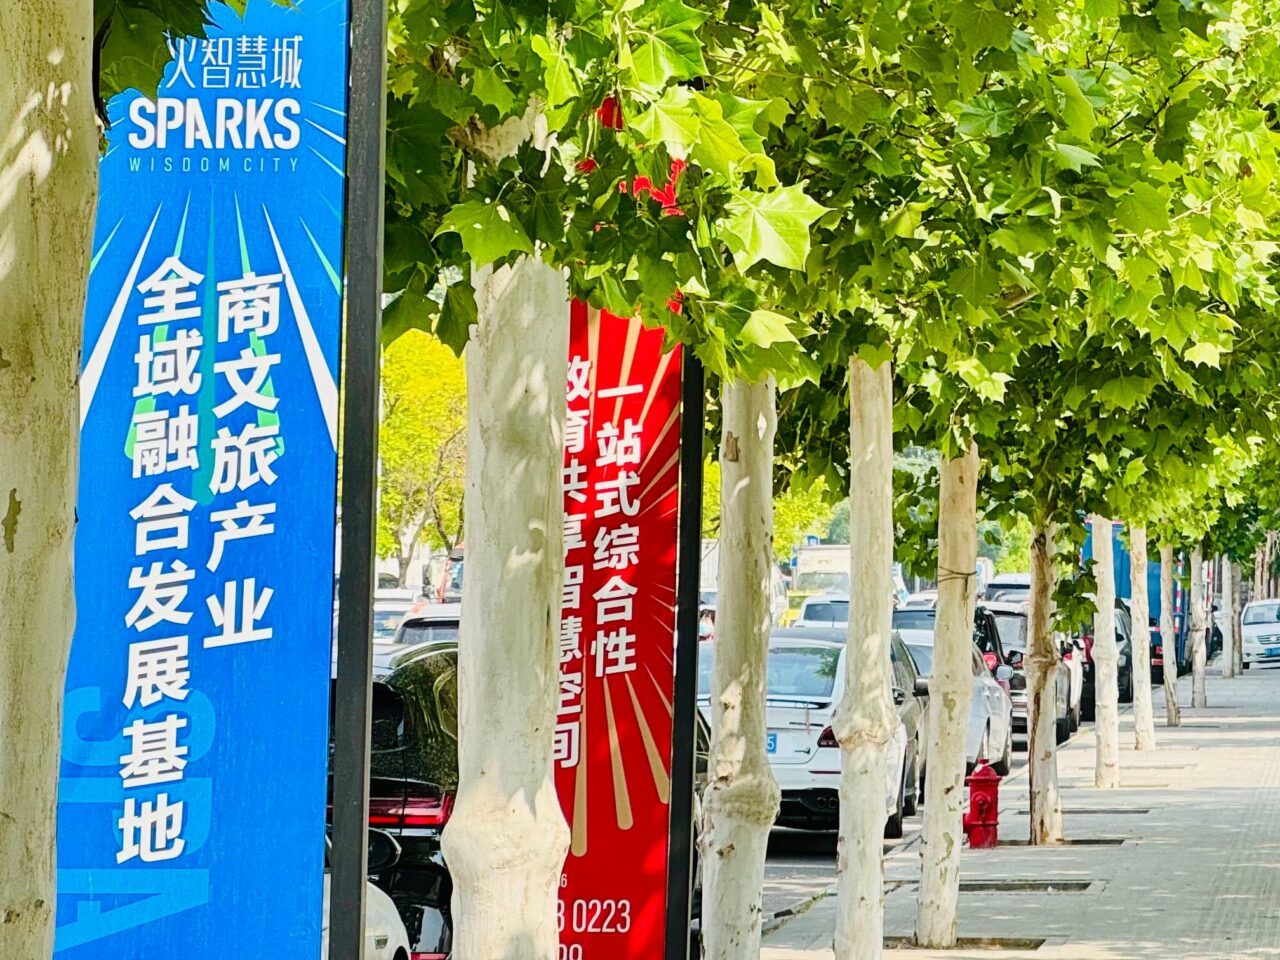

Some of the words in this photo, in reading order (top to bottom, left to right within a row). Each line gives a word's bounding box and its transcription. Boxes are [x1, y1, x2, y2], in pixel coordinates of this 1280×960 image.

[158, 34, 304, 89] 火智慧城
[128, 97, 301, 150] SPARKS
[129, 157, 230, 172] WISDOM
[243, 157, 299, 172] CITY
[203, 270, 284, 649] 商文旅产业
[590, 383, 644, 678] 一站式综合性
[116, 256, 205, 864] 全域融合发展基地
[572, 899, 631, 933] 0223
